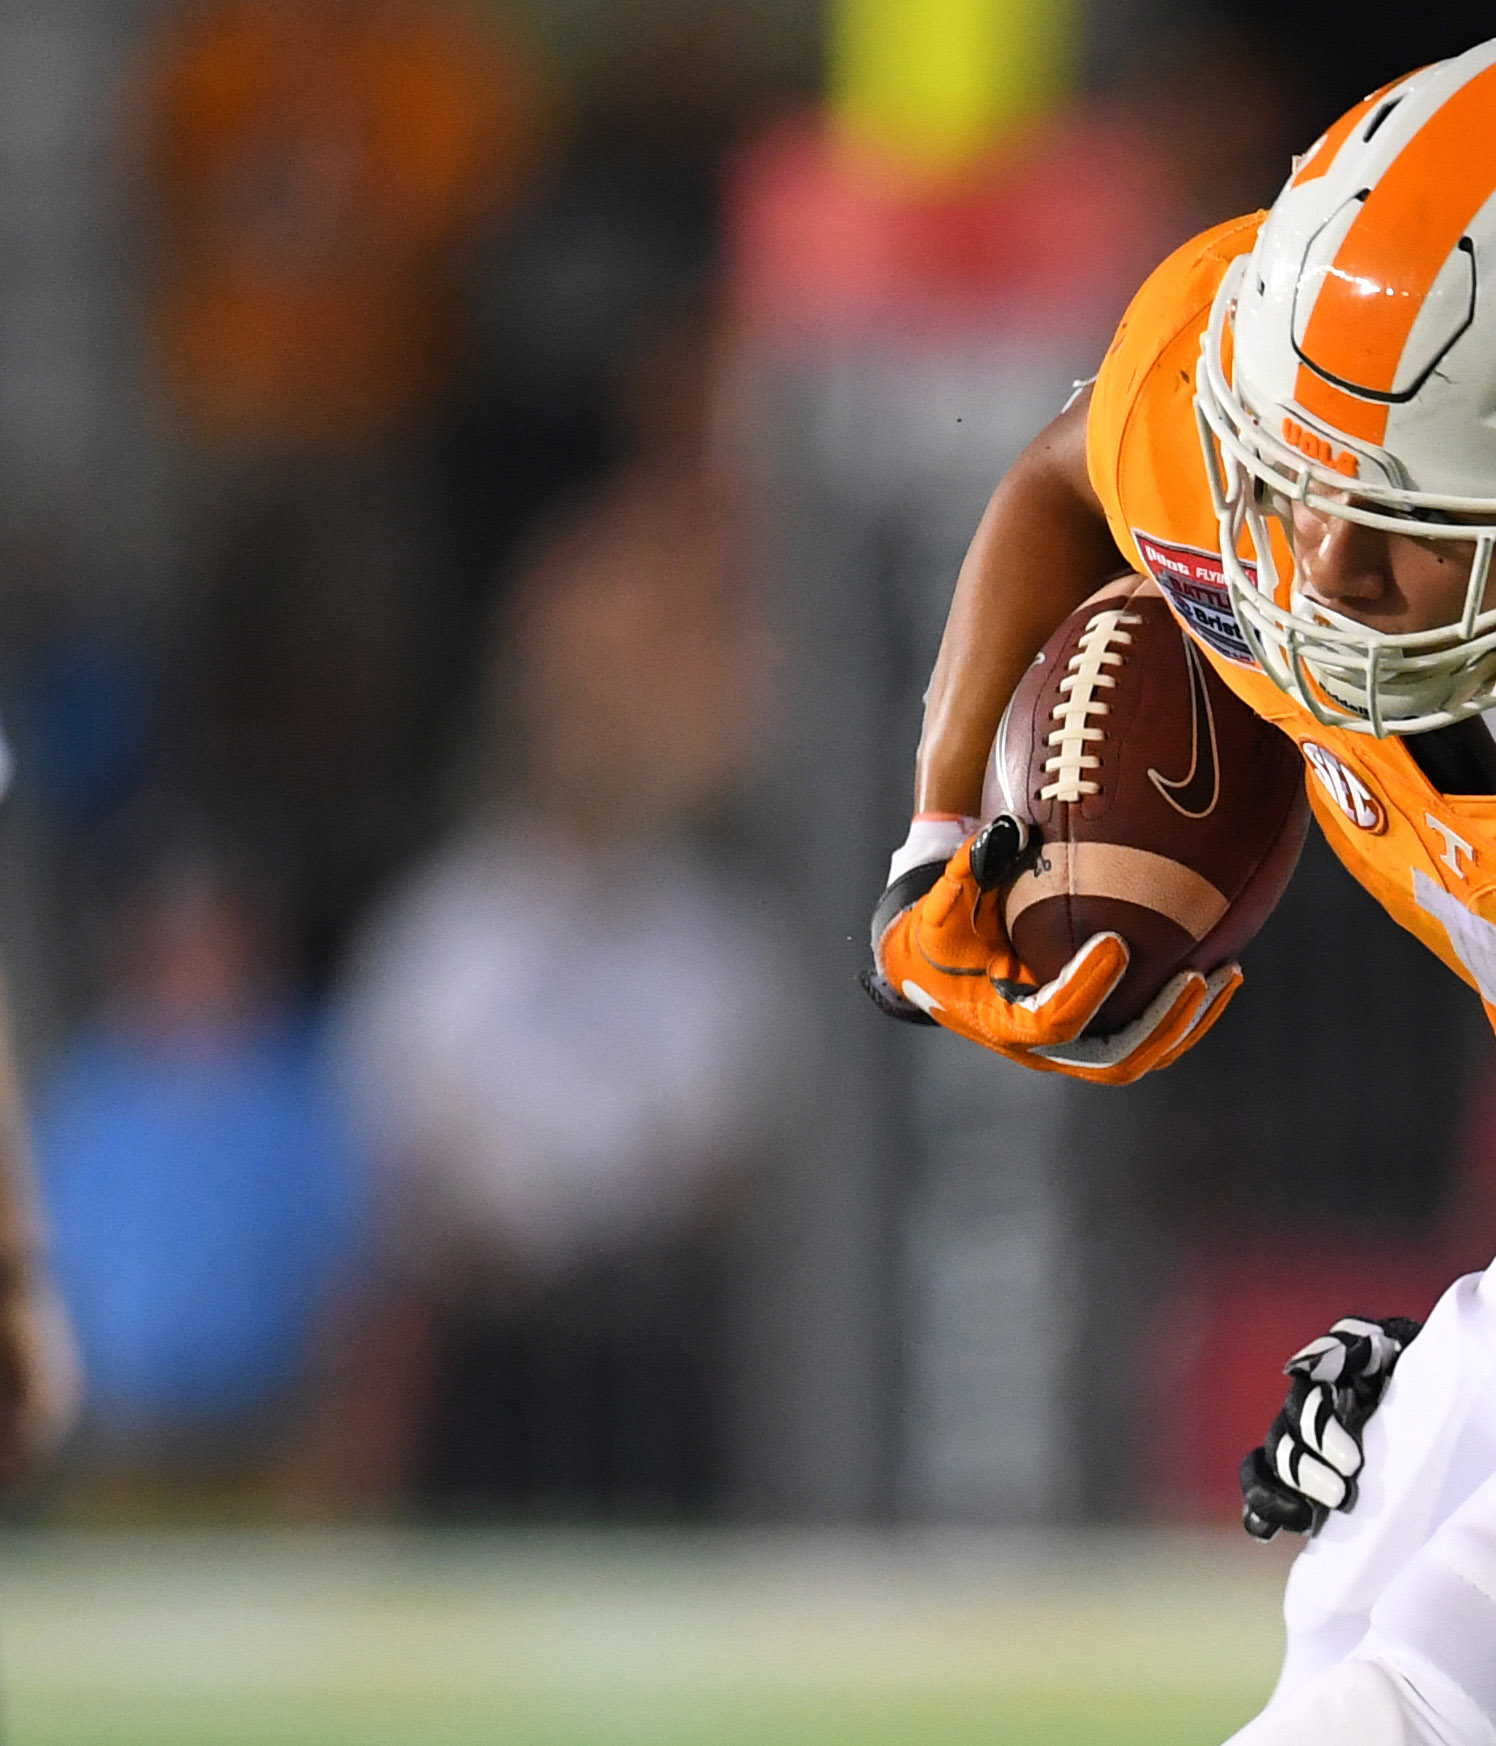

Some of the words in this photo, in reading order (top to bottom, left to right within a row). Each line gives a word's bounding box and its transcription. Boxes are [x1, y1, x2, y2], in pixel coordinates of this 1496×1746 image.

[1168, 575, 1234, 612] BATTL
[1194, 608, 1250, 641] Brist
[1302, 742, 1374, 828] SEC
[1424, 811, 1476, 881] T
